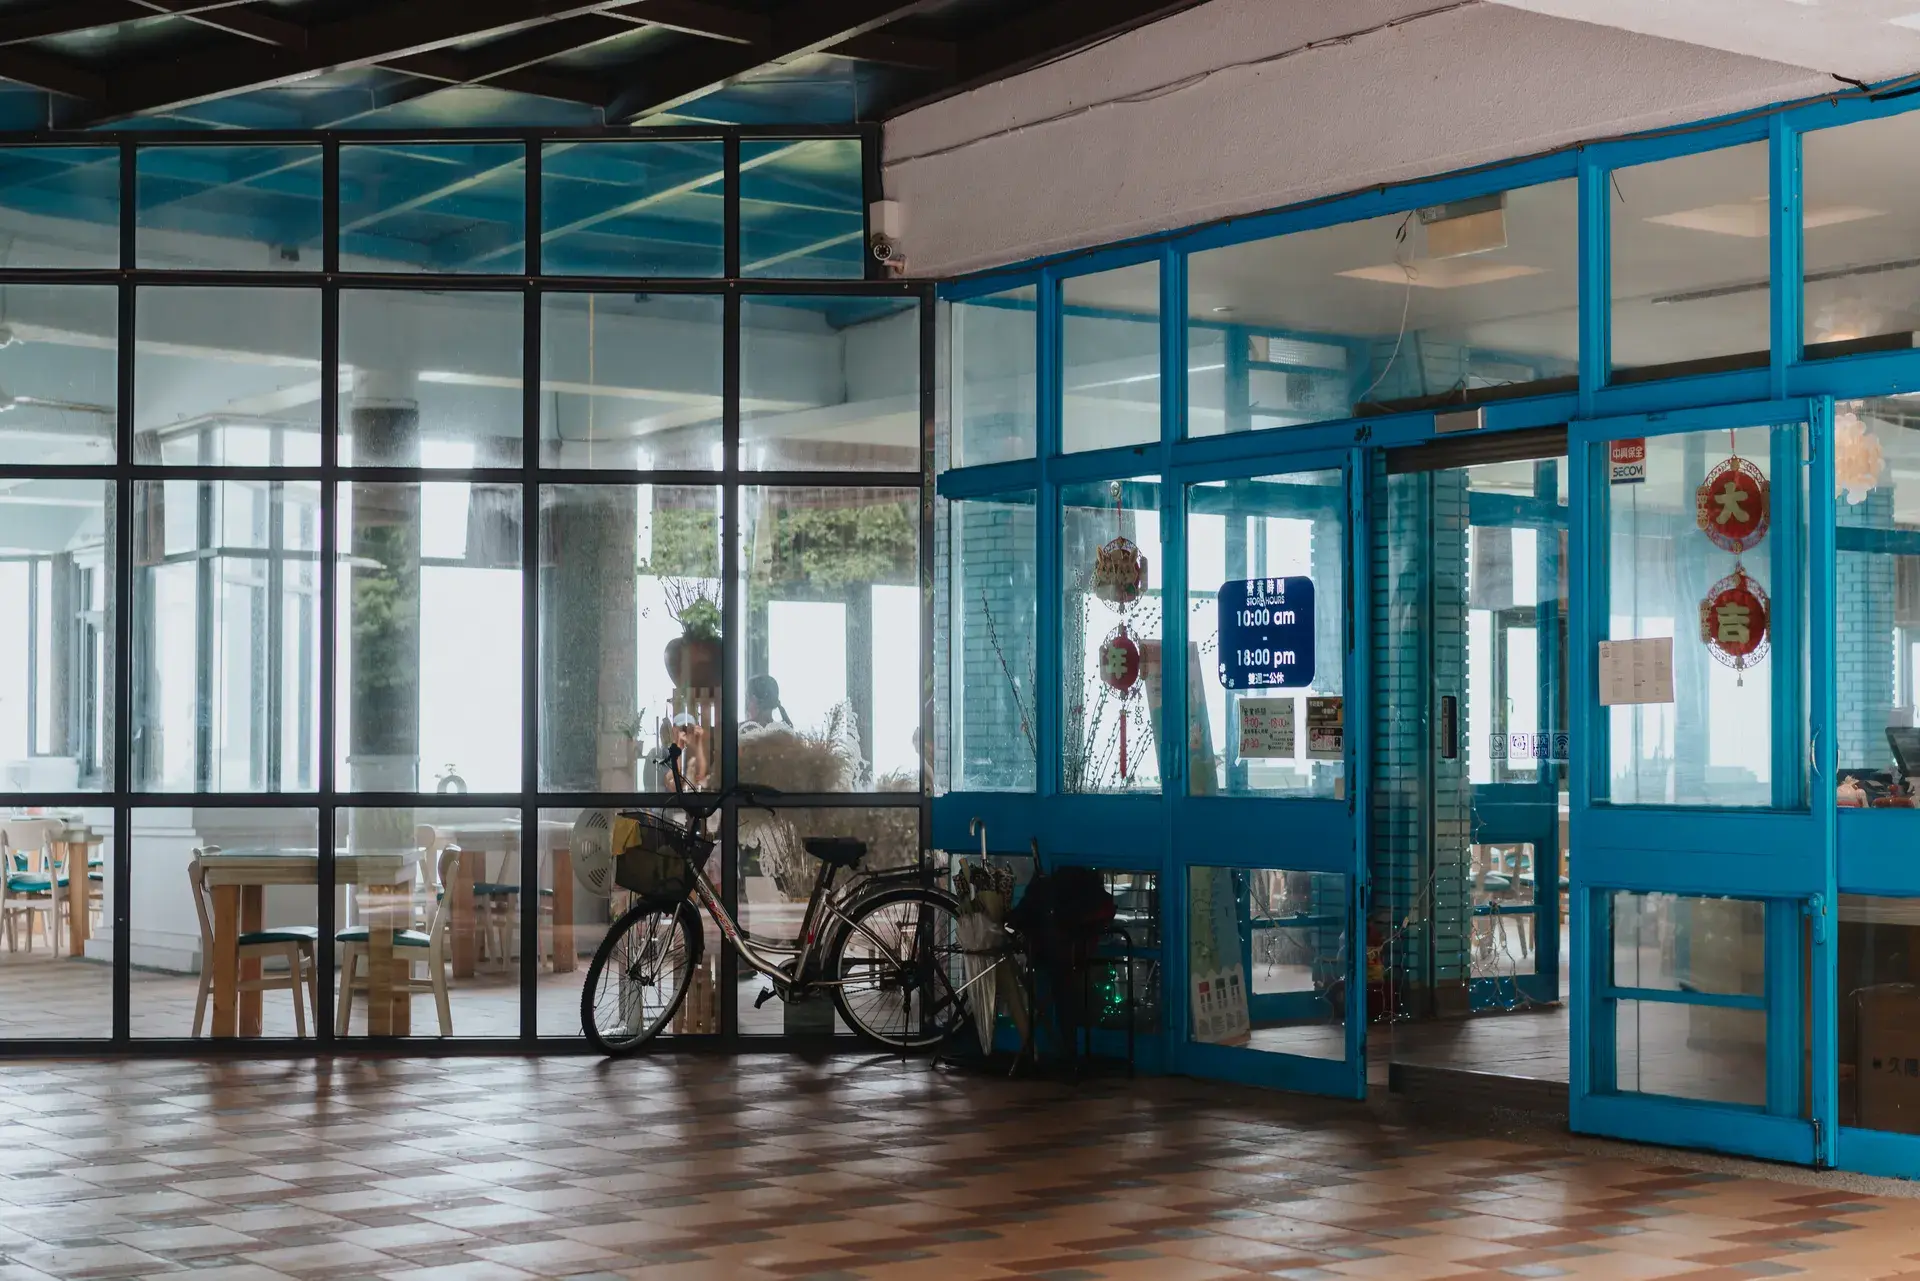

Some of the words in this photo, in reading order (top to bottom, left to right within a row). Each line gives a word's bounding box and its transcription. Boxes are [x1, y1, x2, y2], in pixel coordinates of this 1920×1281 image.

[1612, 446, 1643, 459] 中興保全
[1613, 466, 1643, 477] SECOM
[1714, 482, 1750, 525] 大
[1246, 579, 1285, 596] 營業時間
[1265, 595, 1285, 605] HOURS
[1237, 609, 1270, 627] 10:00
[1273, 610, 1295, 625] am
[1716, 602, 1751, 643] 吉
[1237, 649, 1270, 666] 18:00
[1274, 651, 1295, 668] pm
